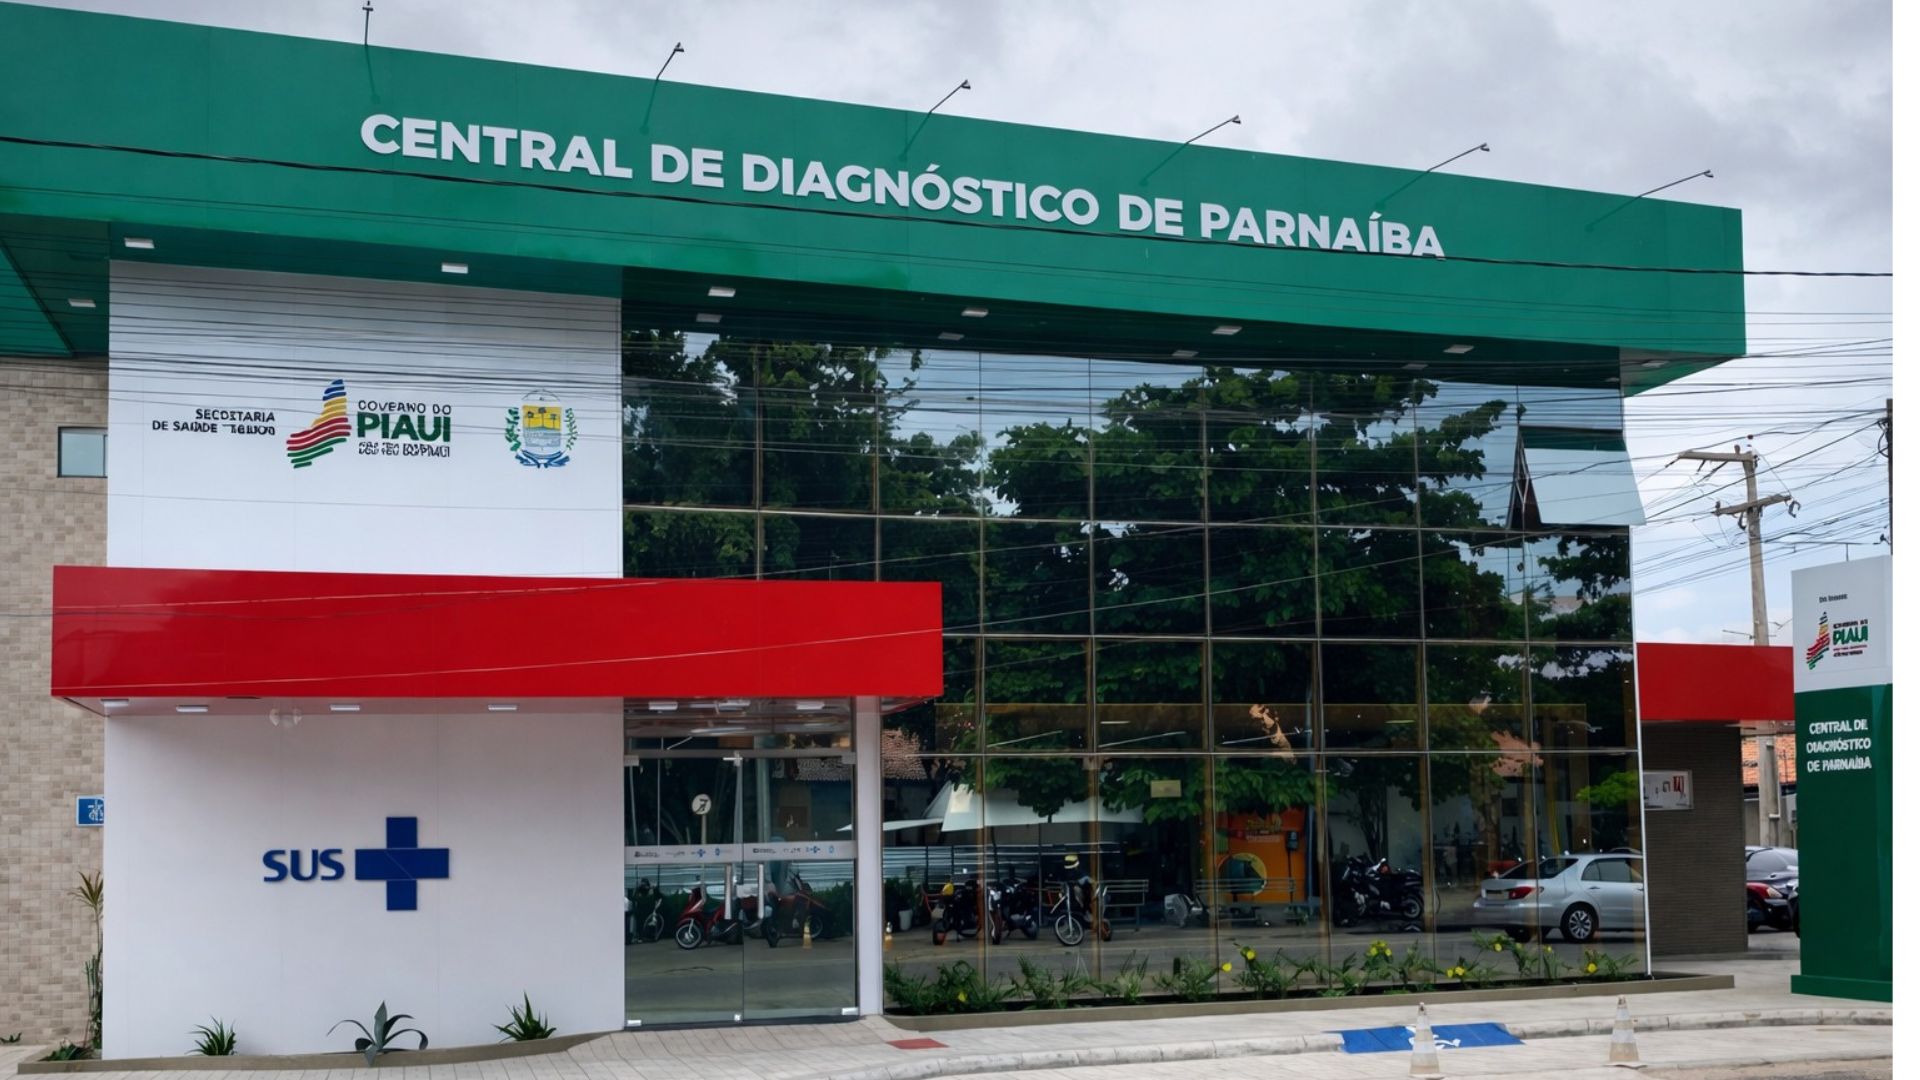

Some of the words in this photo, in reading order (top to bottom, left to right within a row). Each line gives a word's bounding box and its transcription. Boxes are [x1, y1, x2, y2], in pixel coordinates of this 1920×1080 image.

[360, 113, 634, 180] CENTRAL
[651, 143, 725, 188] DE
[742, 153, 1100, 225] DIAGNÓSTICO
[1118, 193, 1185, 237] DE
[1200, 202, 1446, 260] PARNAÍBA
[262, 848, 346, 883] SUS
